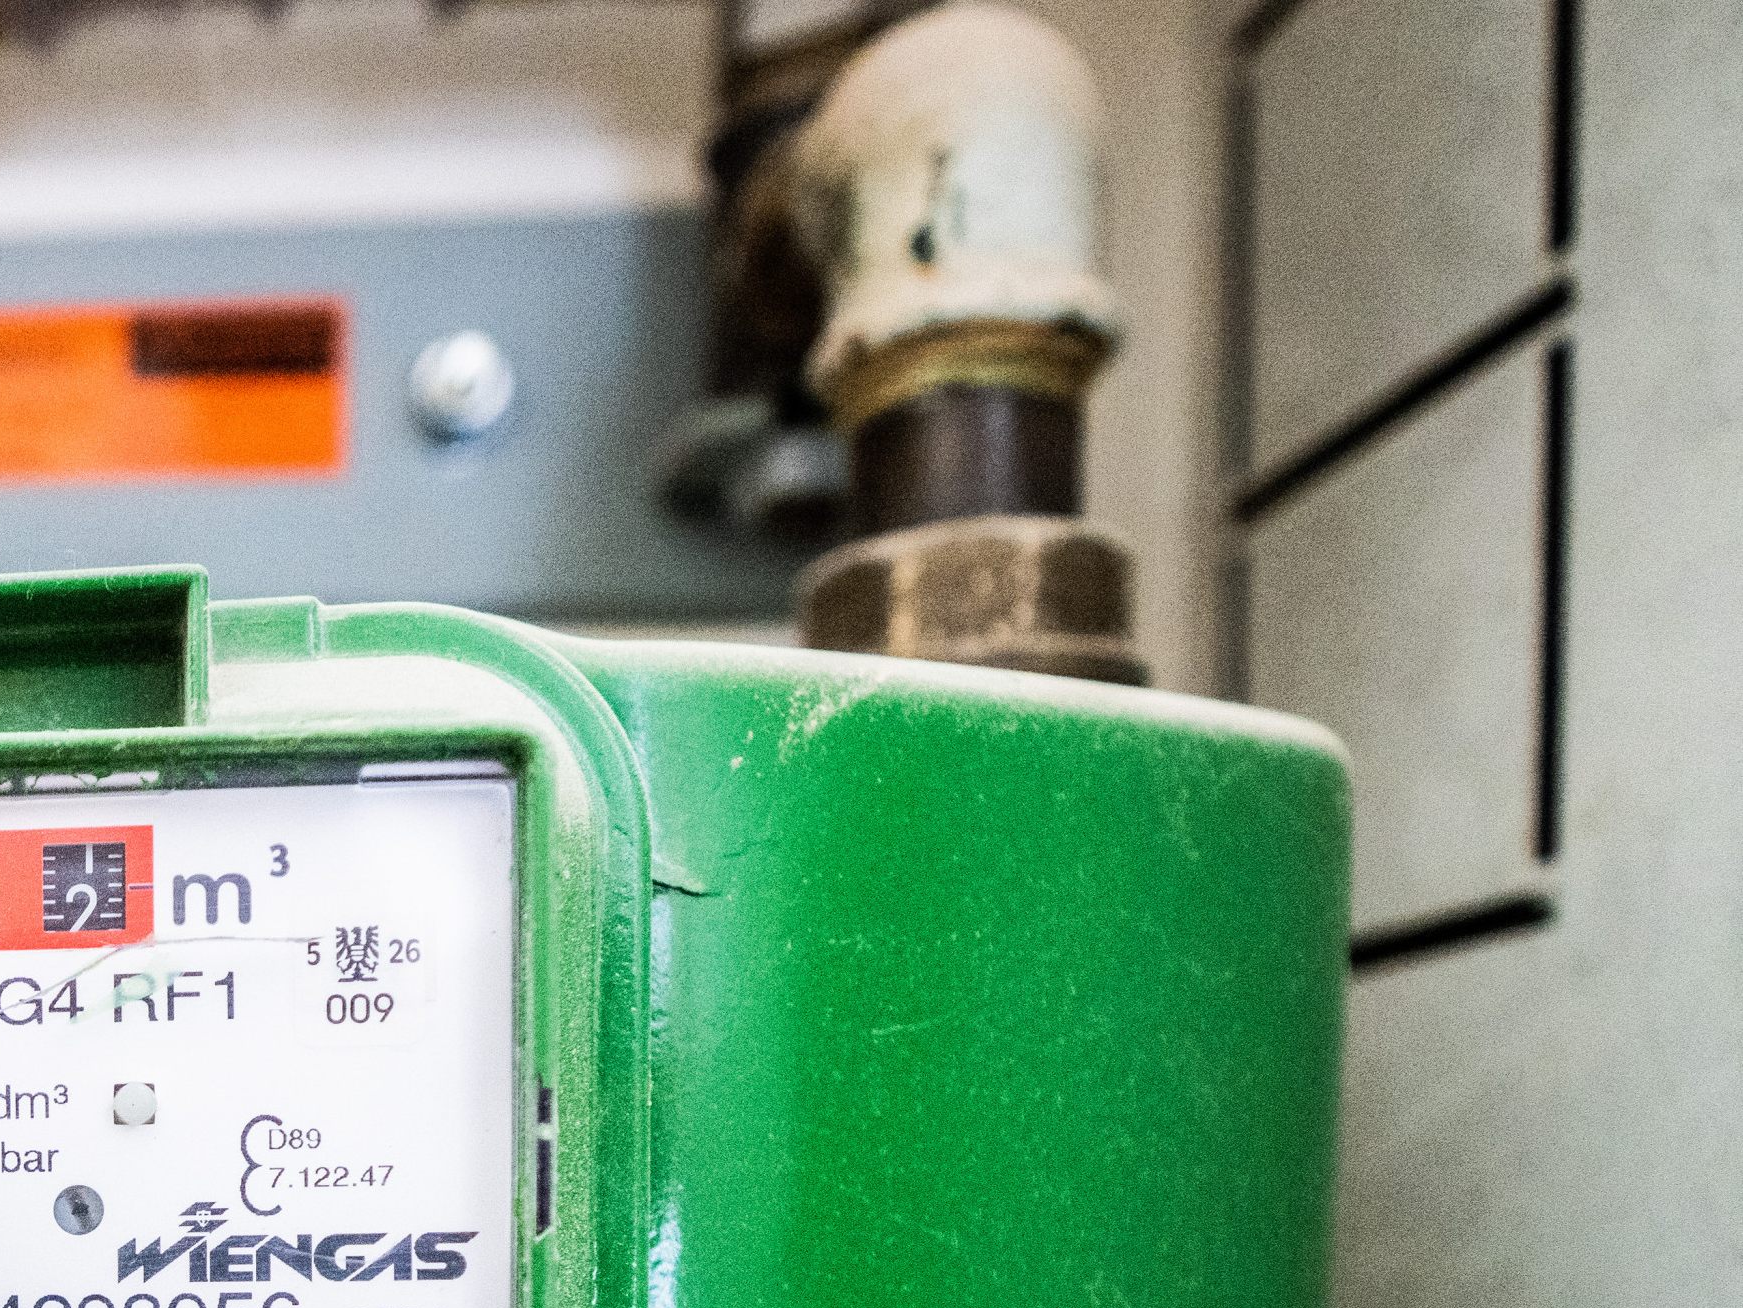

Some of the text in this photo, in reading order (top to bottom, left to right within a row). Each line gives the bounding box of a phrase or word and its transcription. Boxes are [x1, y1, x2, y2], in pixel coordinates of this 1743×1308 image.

[307, 938, 421, 966] 5 26
[113, 971, 237, 1024] RF1
[326, 992, 395, 1025] 009
[268, 1128, 322, 1150] D89
[0, 1141, 60, 1173] bar
[269, 1164, 395, 1189] 7.122.47
[117, 1231, 479, 1284] WIENGAS
